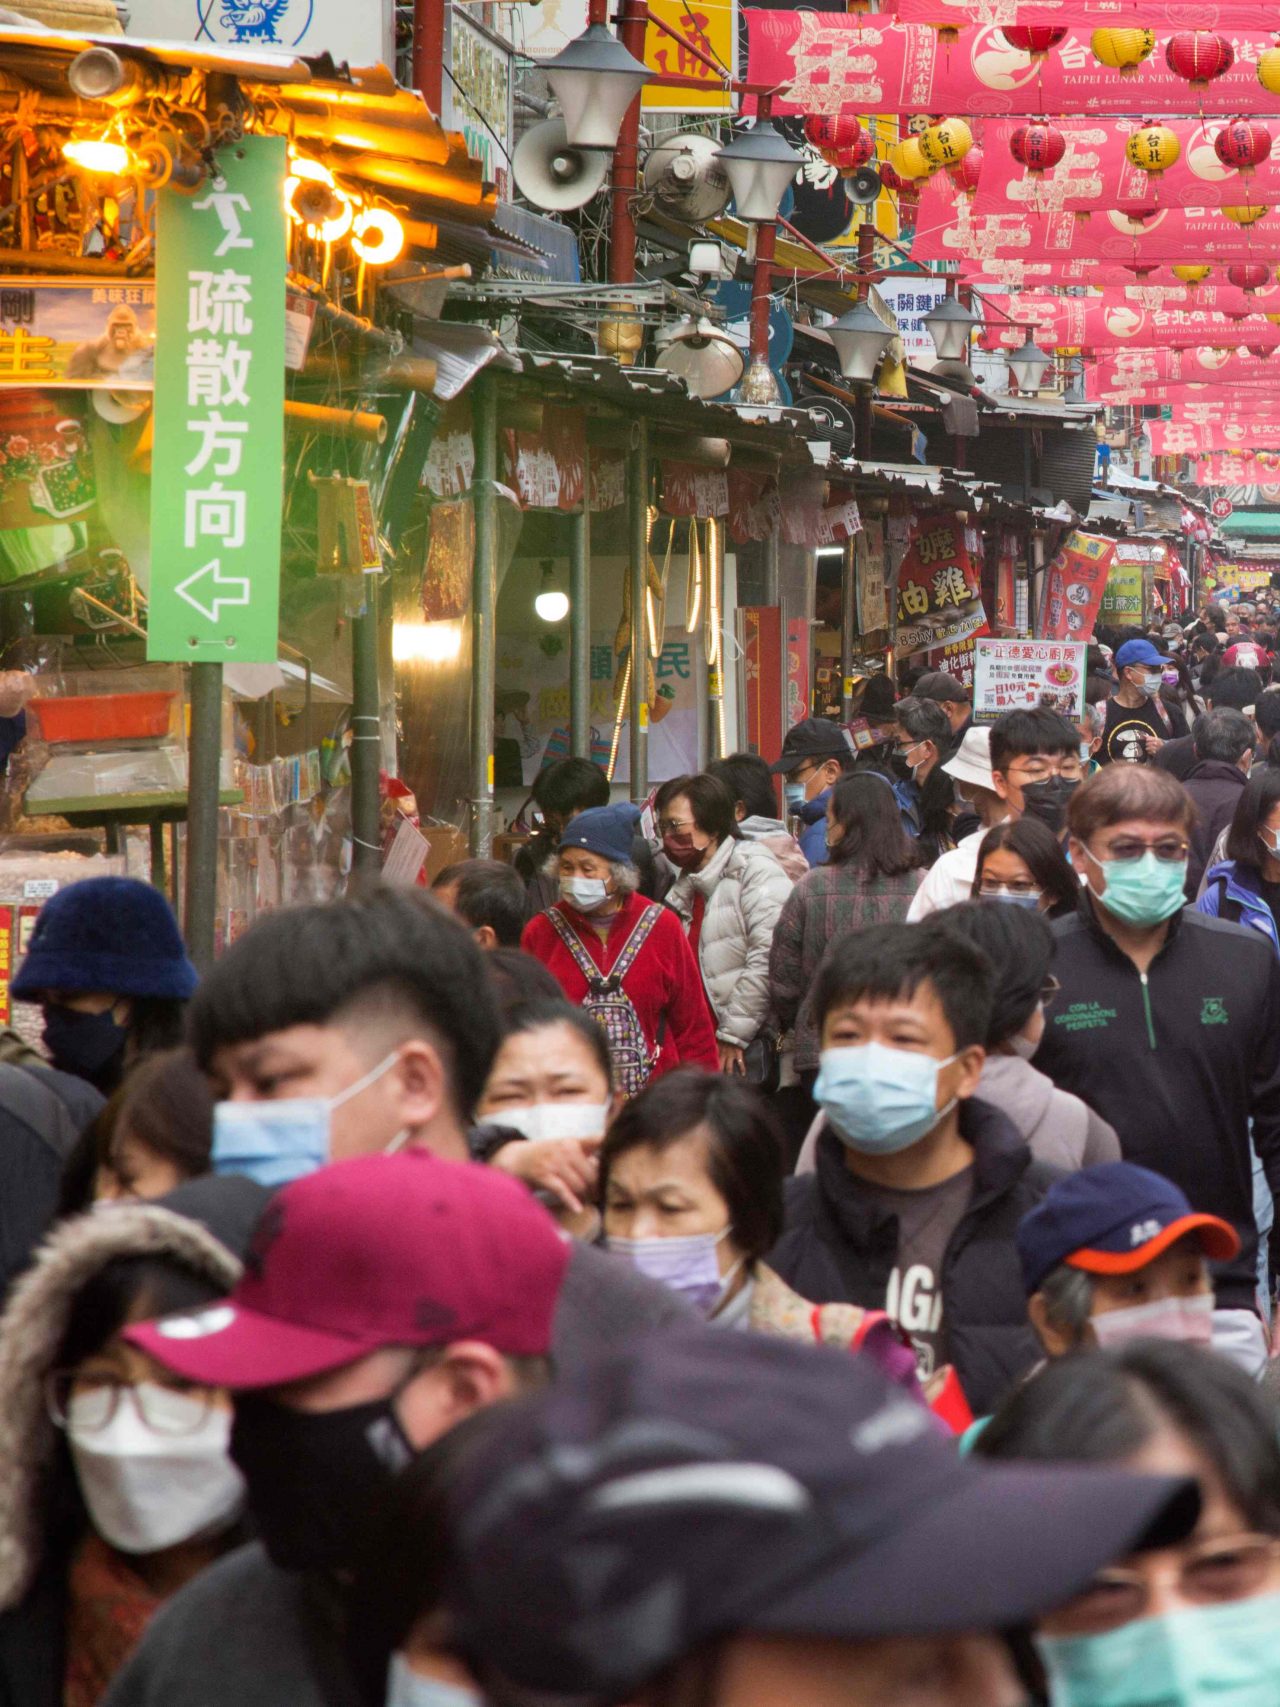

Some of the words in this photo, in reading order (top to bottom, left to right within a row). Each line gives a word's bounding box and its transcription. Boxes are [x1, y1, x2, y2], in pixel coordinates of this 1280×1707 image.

[1063, 76, 1101, 85] TAIPEI
[1105, 75, 1144, 84] LUNAR
[1148, 74, 1176, 83] NEW
[1147, 134, 1162, 163] 台北
[1184, 222, 1217, 231] TAIPEI
[1258, 222, 1280, 230] NEW
[183, 268, 254, 549] 疏散方向
[1104, 596, 1140, 610] 甘蔗汁
